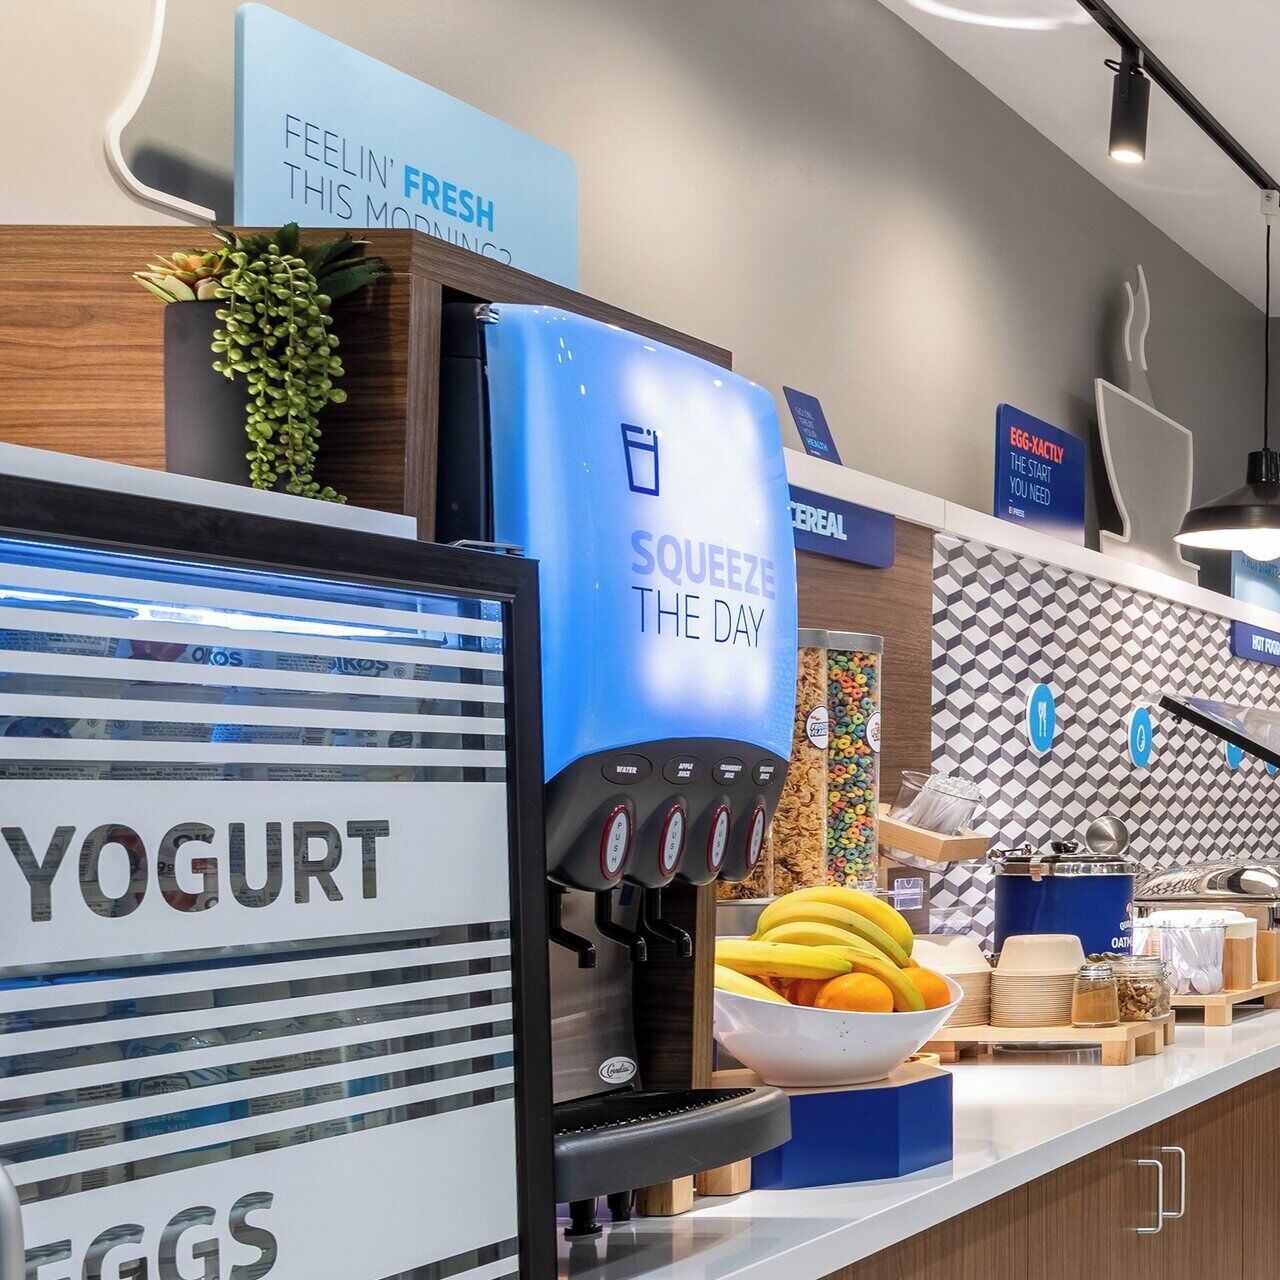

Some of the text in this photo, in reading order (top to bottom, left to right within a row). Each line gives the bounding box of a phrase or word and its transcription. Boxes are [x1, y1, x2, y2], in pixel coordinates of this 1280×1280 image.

[283, 161, 353, 219] THIS
[285, 113, 494, 232] FEELIN' FRESH
[1009, 425, 1064, 464] EGG-XACTLY
[1010, 451, 1052, 483] THE START
[1009, 475, 1051, 505] YOU NEED
[789, 500, 848, 541] CEREAL
[630, 529, 775, 600] SQUEEZE
[631, 585, 765, 648] THE DAY
[1252, 634, 1280, 656] HOT FOOD
[616, 766, 637, 774] WATER
[611, 822, 622, 863] PUSH
[668, 820, 678, 860] PUSH
[715, 819, 724, 857] PUSH
[0, 820, 390, 923] YOGURT
[1111, 936, 1134, 949] OATM
